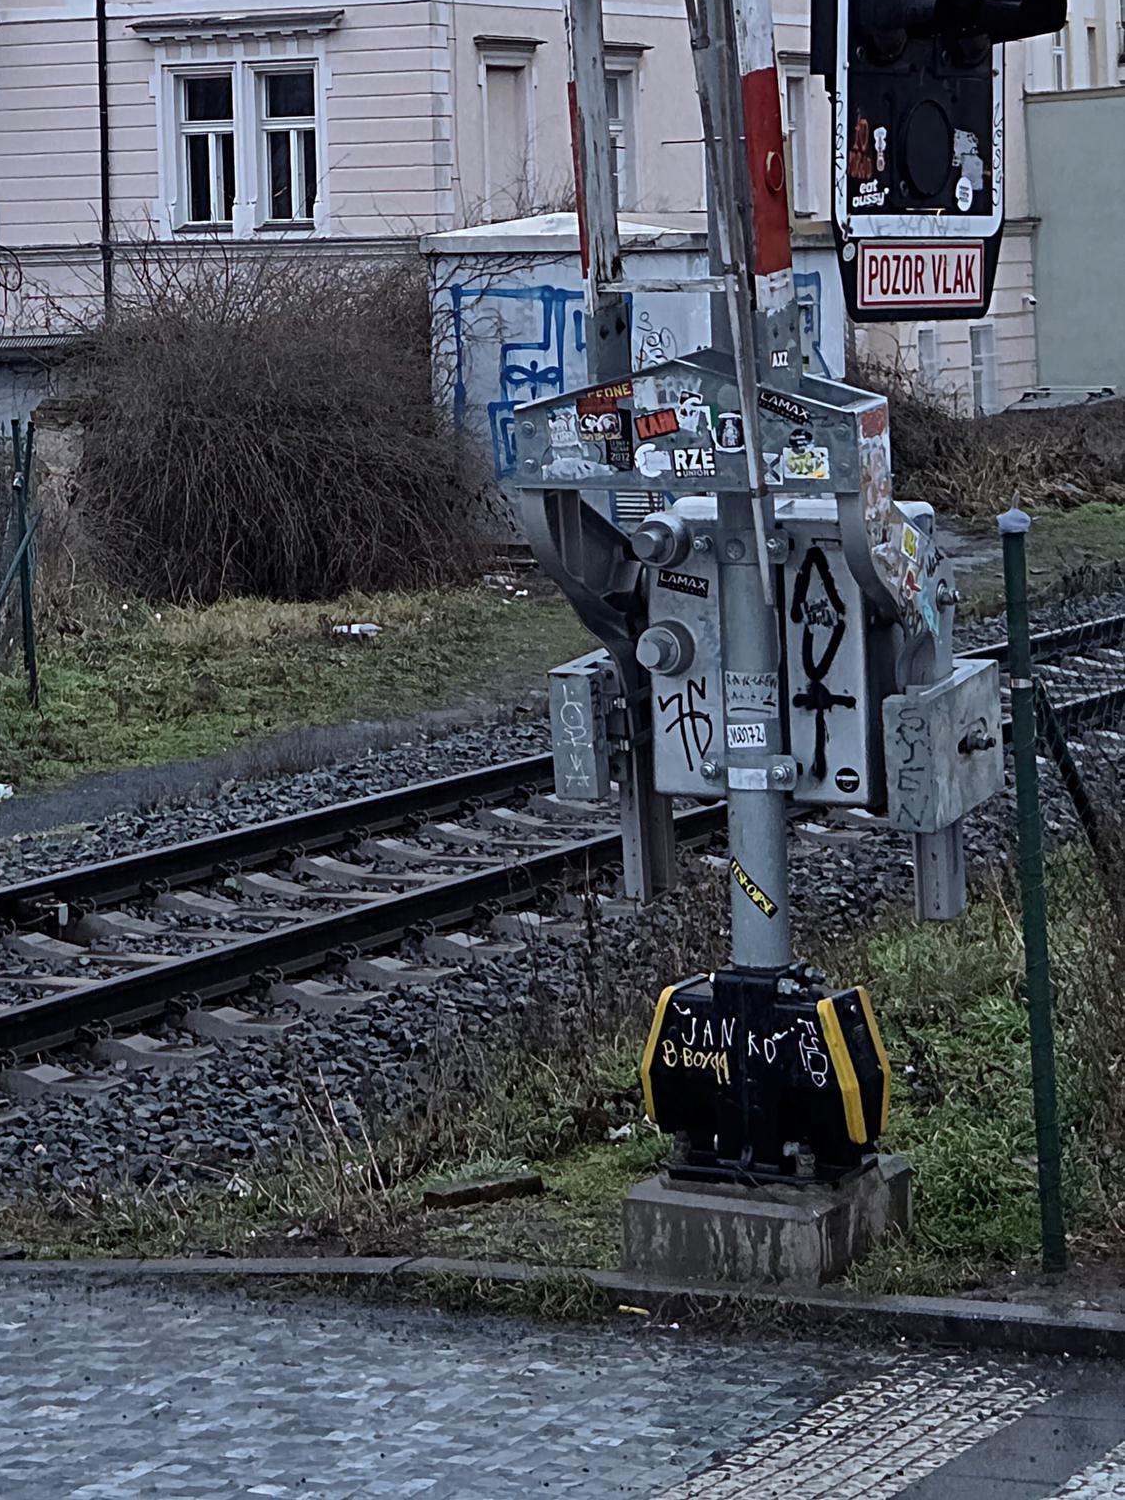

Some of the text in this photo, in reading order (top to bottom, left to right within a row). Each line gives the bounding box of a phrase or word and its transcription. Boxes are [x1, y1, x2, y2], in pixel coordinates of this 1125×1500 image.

[868, 253, 976, 296] POZOR VLAK
[760, 391, 810, 420] LAMAX
[609, 451, 631, 462] 2012
[675, 447, 716, 471] RZE
[683, 469, 710, 478] UNION
[659, 573, 708, 592] LAMAX
